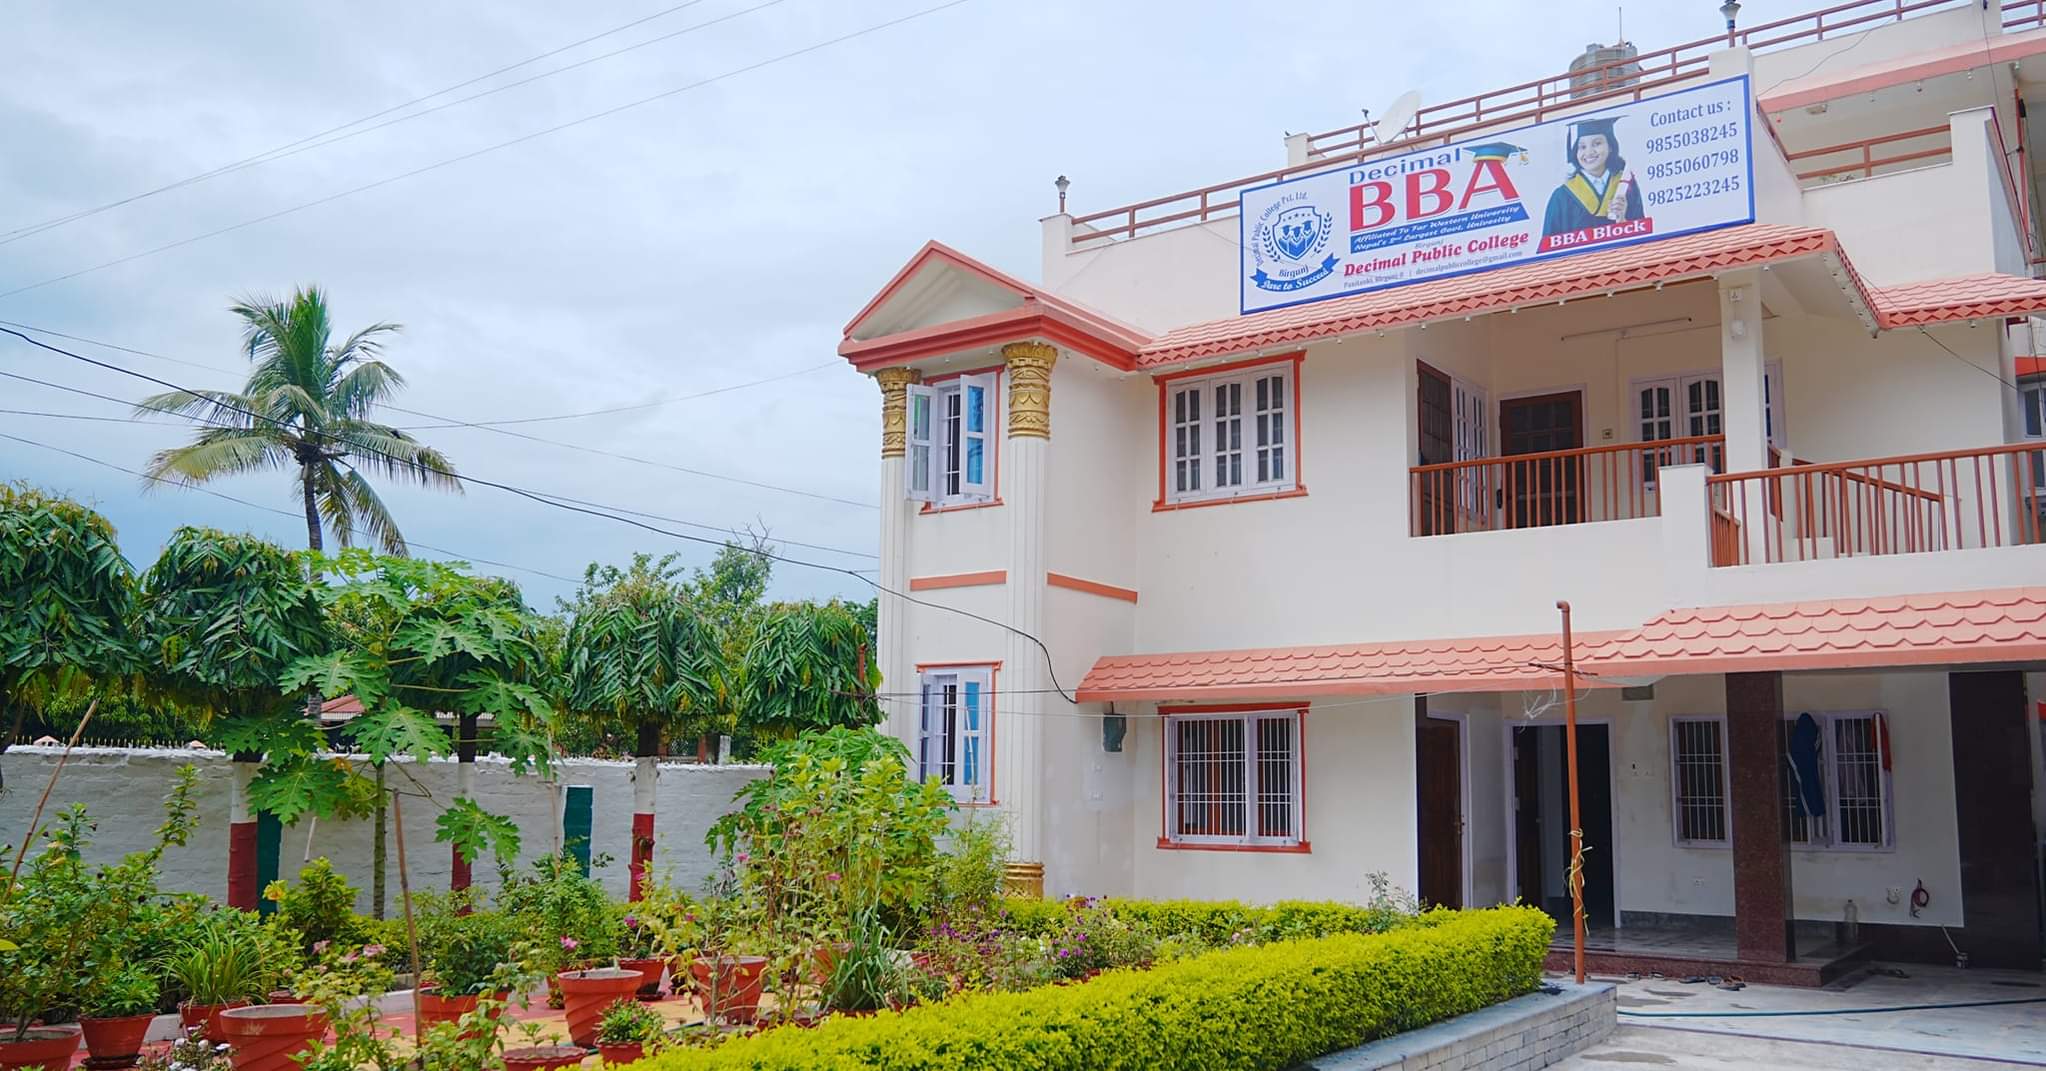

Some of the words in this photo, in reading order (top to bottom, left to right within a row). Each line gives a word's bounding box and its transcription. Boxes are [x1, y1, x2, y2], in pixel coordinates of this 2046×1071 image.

[1650, 104, 1703, 127] Contact
[1707, 101, 1723, 115] us
[1646, 122, 1737, 154] 9855038245
[1350, 148, 1460, 184] Decimal
[1647, 148, 1739, 180] 9855060798
[1350, 160, 1520, 232] BBA
[1648, 175, 1740, 206] 9825223245
[1260, 201, 1281, 222] College
[1471, 206, 1520, 220] University
[1550, 229, 1588, 247] BBA
[1592, 220, 1646, 240] Block
[1344, 253, 1406, 276] Decimal
[1412, 244, 1462, 264] Public
[1467, 231, 1529, 250] College
[1279, 264, 1309, 278] Birgunj
